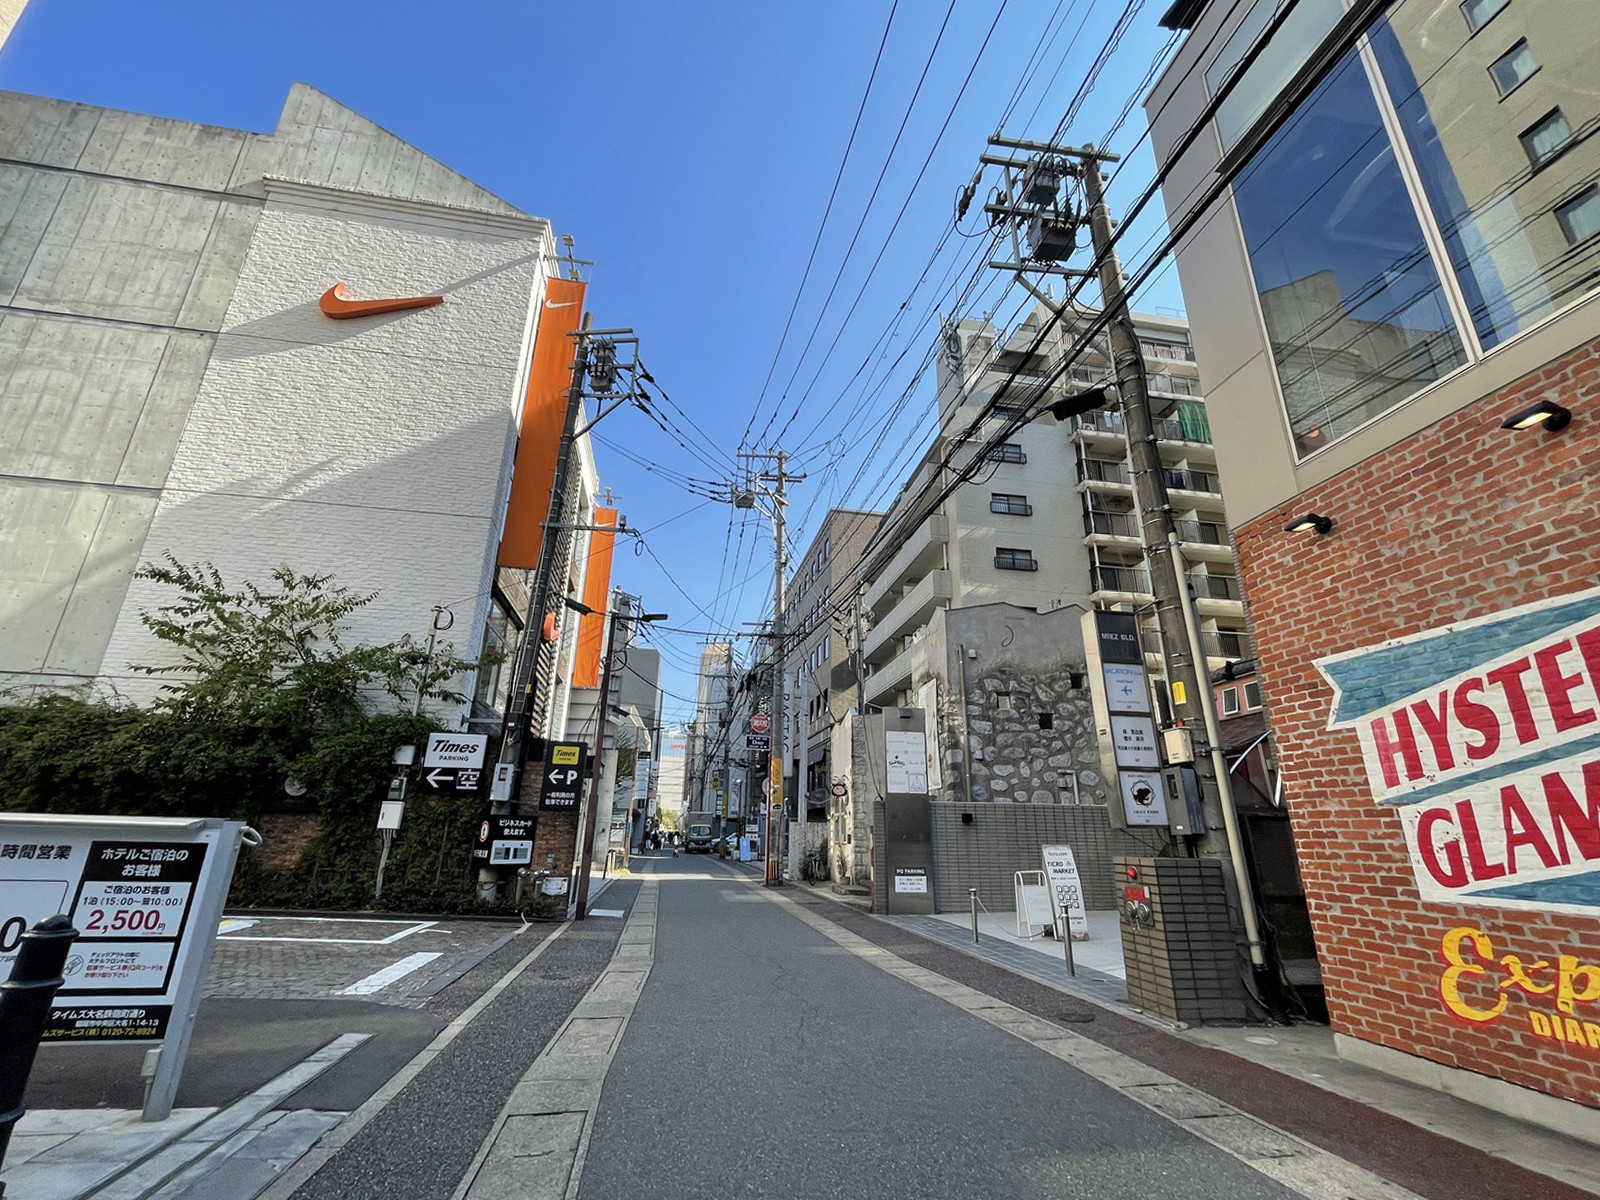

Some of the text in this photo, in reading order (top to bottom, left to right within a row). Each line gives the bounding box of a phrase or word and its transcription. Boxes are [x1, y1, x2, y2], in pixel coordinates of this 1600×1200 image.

[432, 739, 480, 754] Times
[556, 749, 576, 758] Times
[456, 768, 480, 790] 空
[566, 769, 578, 785] P
[499, 818, 533, 828] ビジネスカード
[0, 844, 73, 860] 時間営業
[101, 848, 189, 861] ホテルご宿泊の
[121, 864, 162, 877] お客様
[104, 885, 170, 895] ご宿泊のお客様
